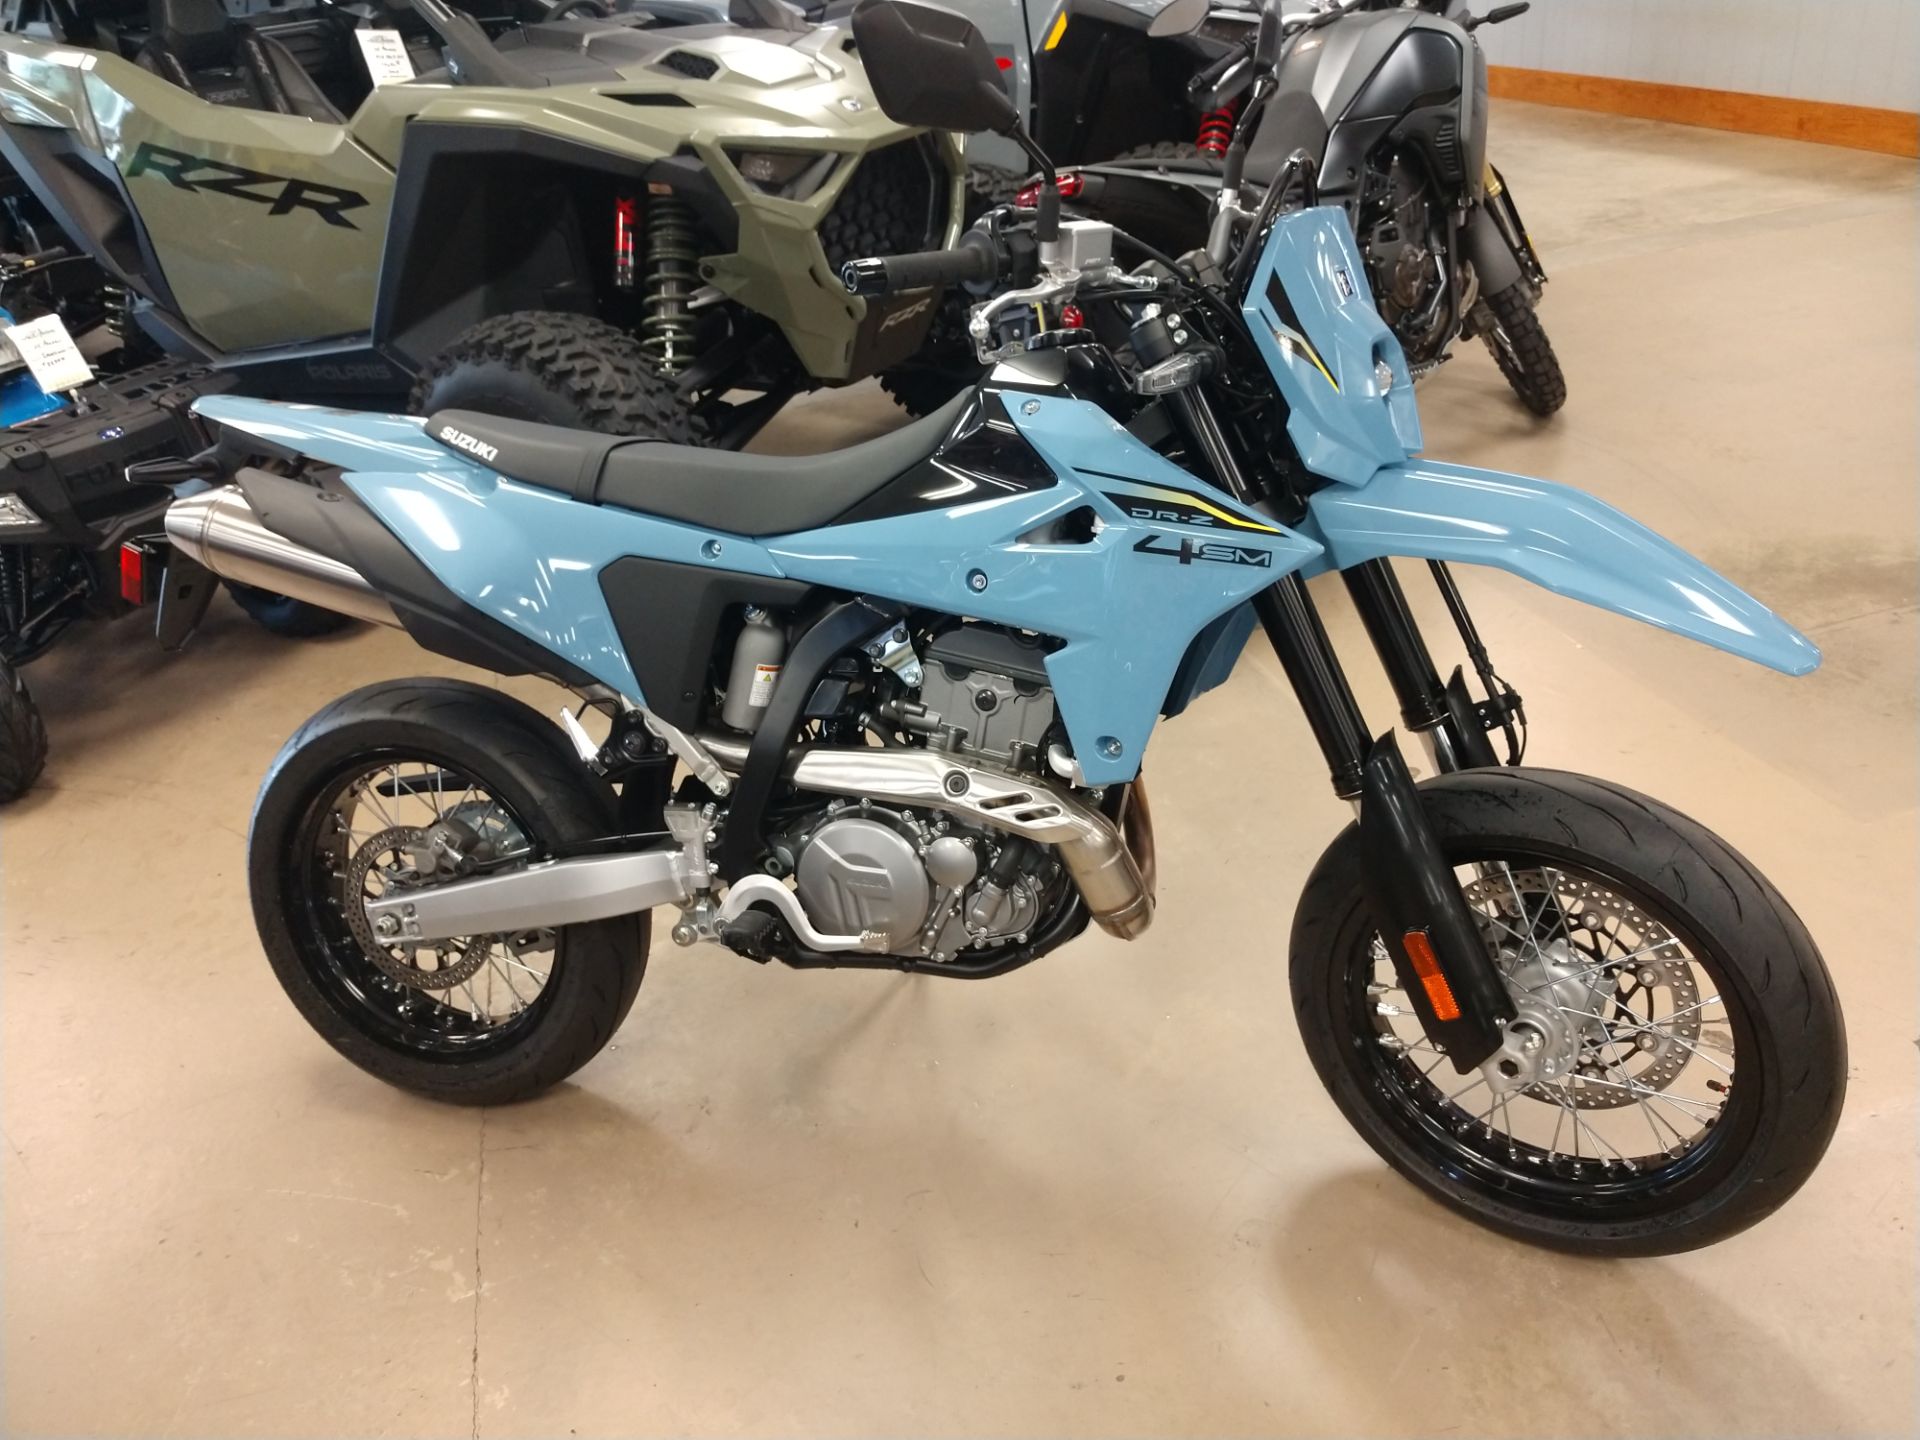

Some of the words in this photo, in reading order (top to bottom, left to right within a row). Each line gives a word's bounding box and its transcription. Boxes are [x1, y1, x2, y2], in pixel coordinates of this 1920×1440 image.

[125, 141, 371, 231] RZR
[878, 297, 932, 333] RZR
[439, 425, 499, 462] SUZUKI
[1130, 507, 1214, 526] DR-Z
